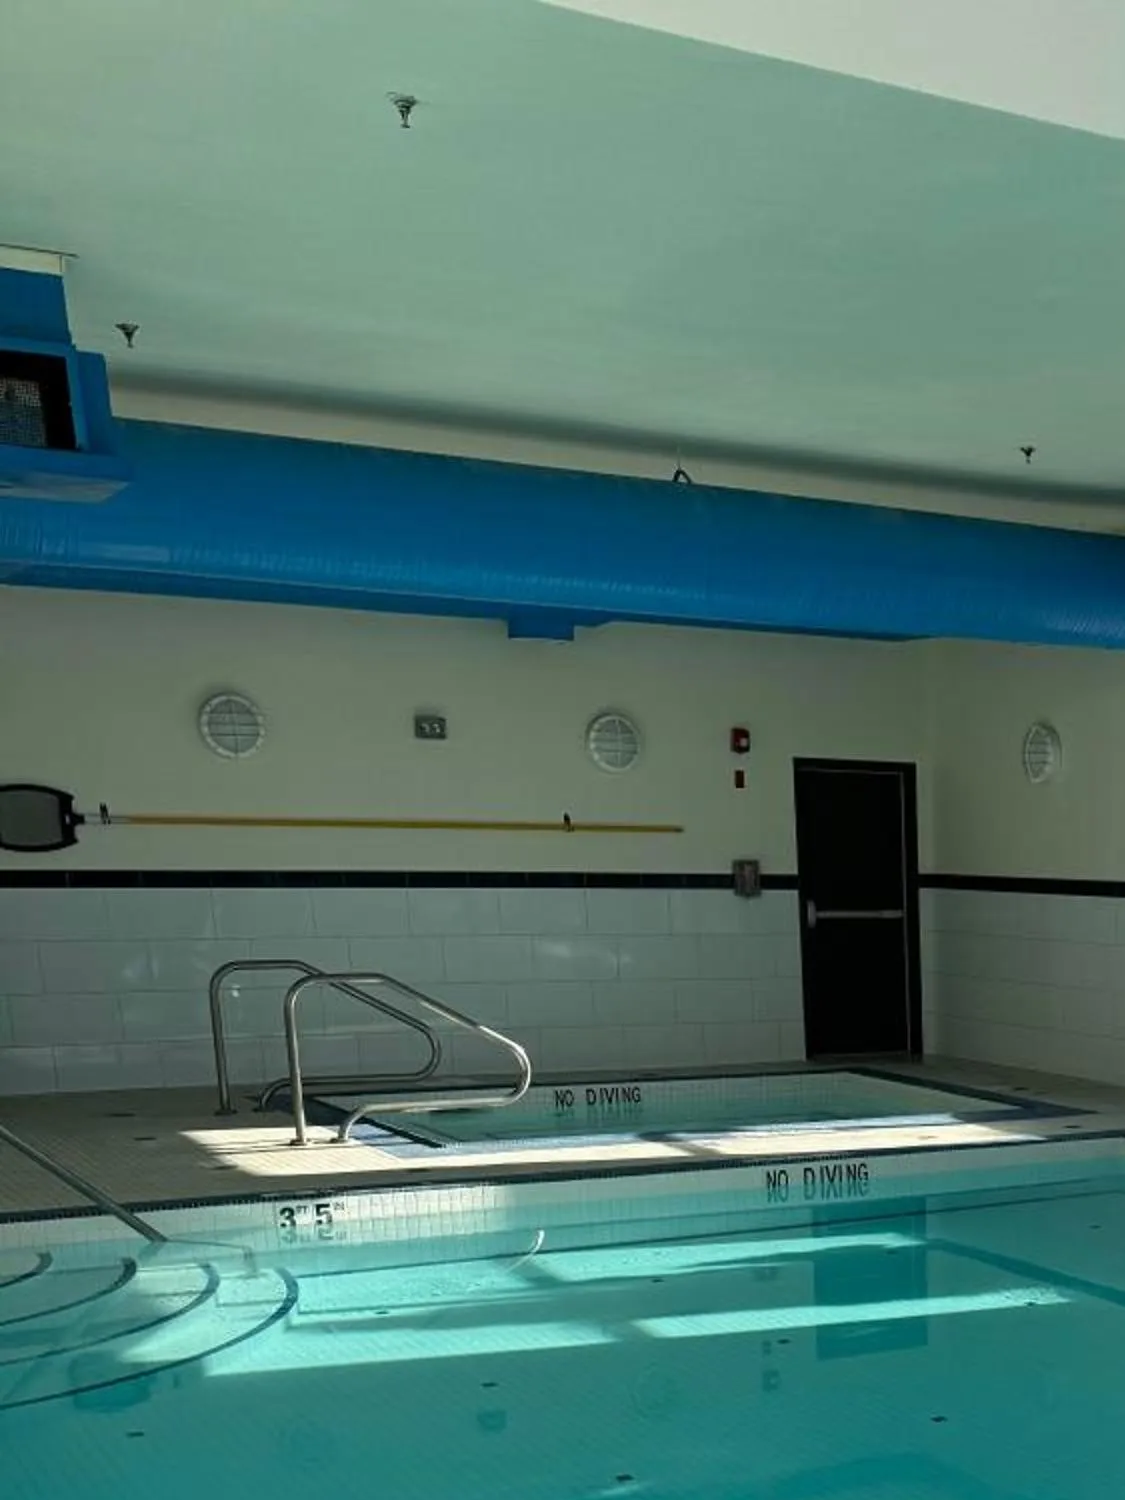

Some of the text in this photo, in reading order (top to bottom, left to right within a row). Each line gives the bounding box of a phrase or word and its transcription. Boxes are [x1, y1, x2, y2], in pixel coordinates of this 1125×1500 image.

[555, 1086, 641, 1108] NO DIVING
[766, 1163, 869, 1188] NO DIVING
